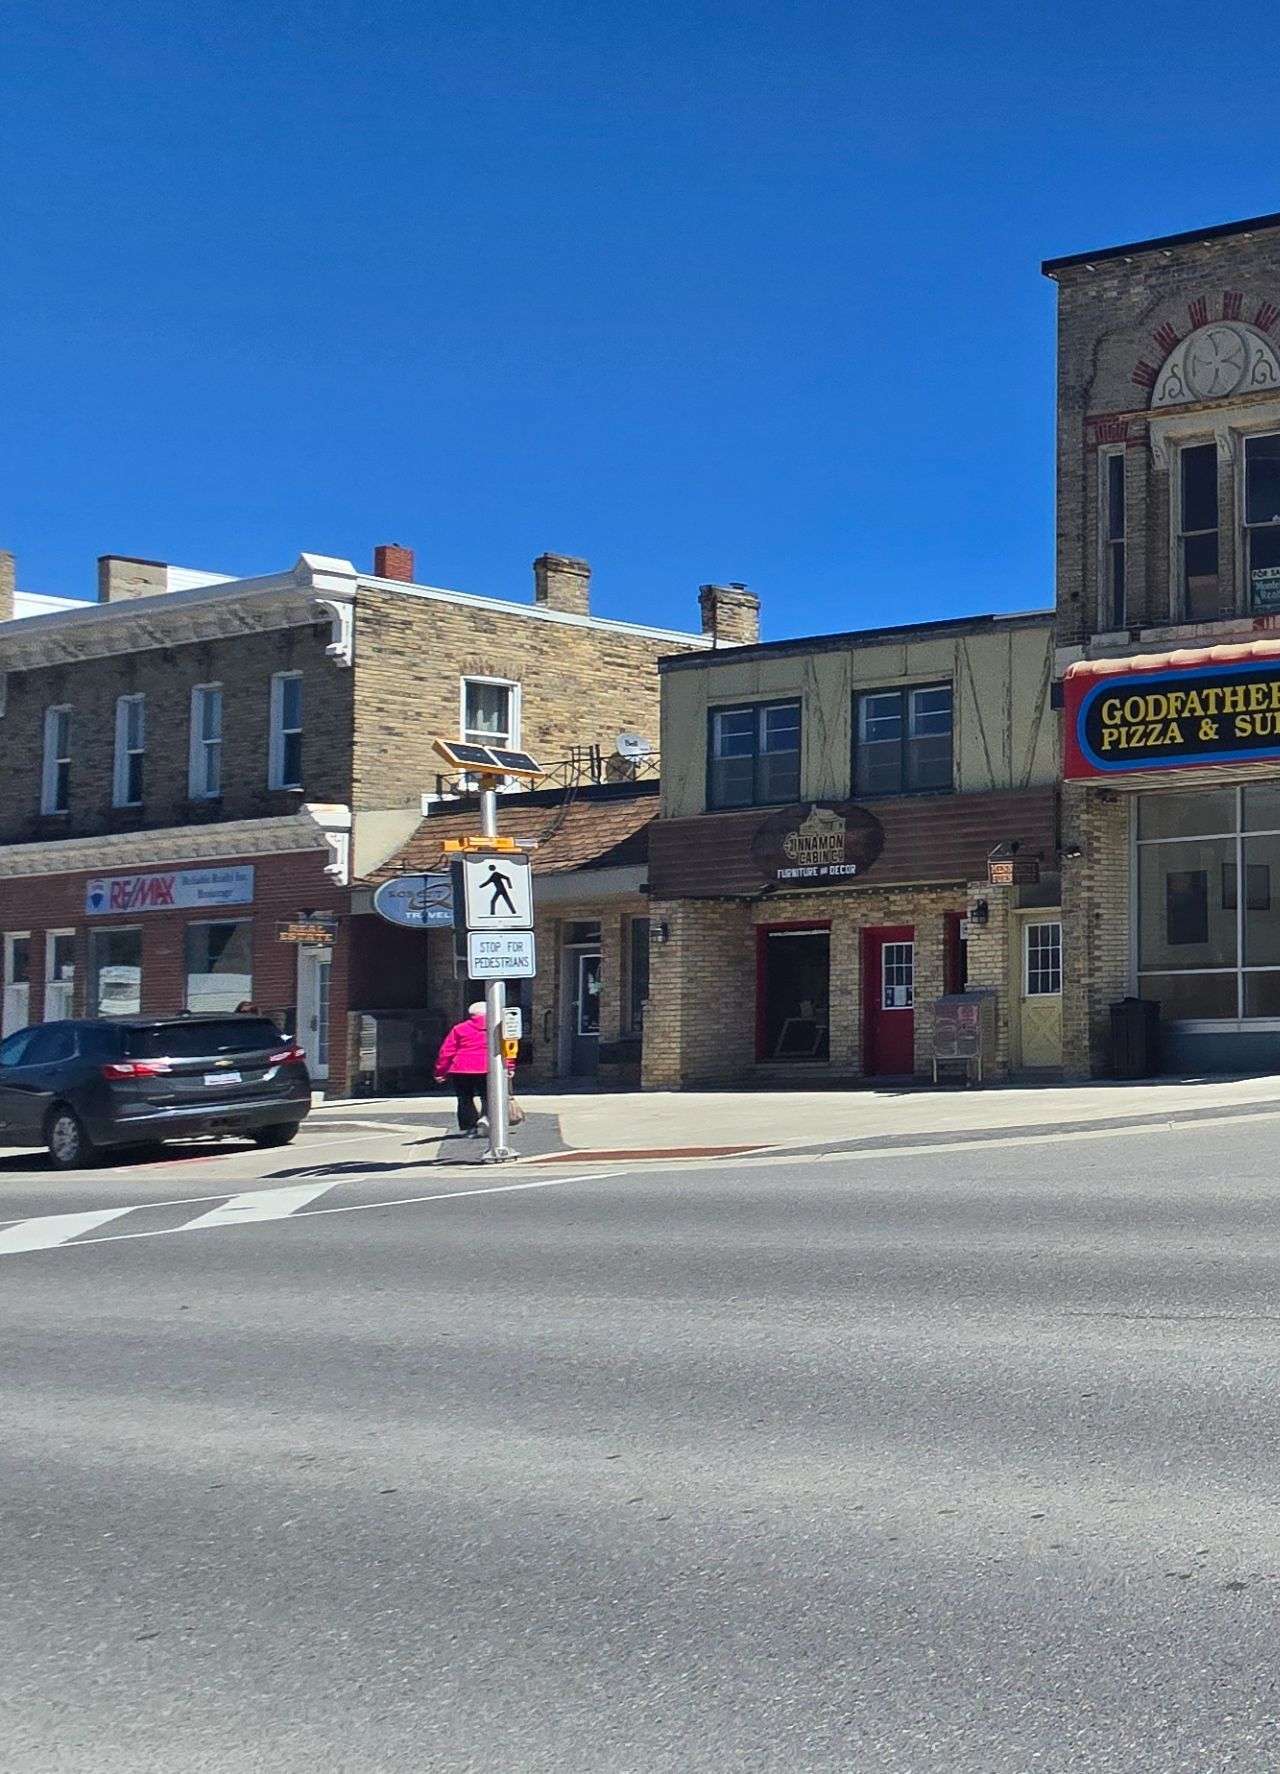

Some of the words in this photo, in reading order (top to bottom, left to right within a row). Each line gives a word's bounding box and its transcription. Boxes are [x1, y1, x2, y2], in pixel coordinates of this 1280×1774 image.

[1101, 721, 1184, 750] PIZZA
[1198, 719, 1219, 741] &
[783, 832, 844, 859] CINNAMON
[829, 864, 856, 875] DECOR
[110, 876, 175, 910] RE/MAX
[279, 932, 334, 942] ESTATE
[480, 942, 500, 953] STOP
[507, 941, 523, 952] FOR
[474, 956, 529, 969] PEDESTRIANS
